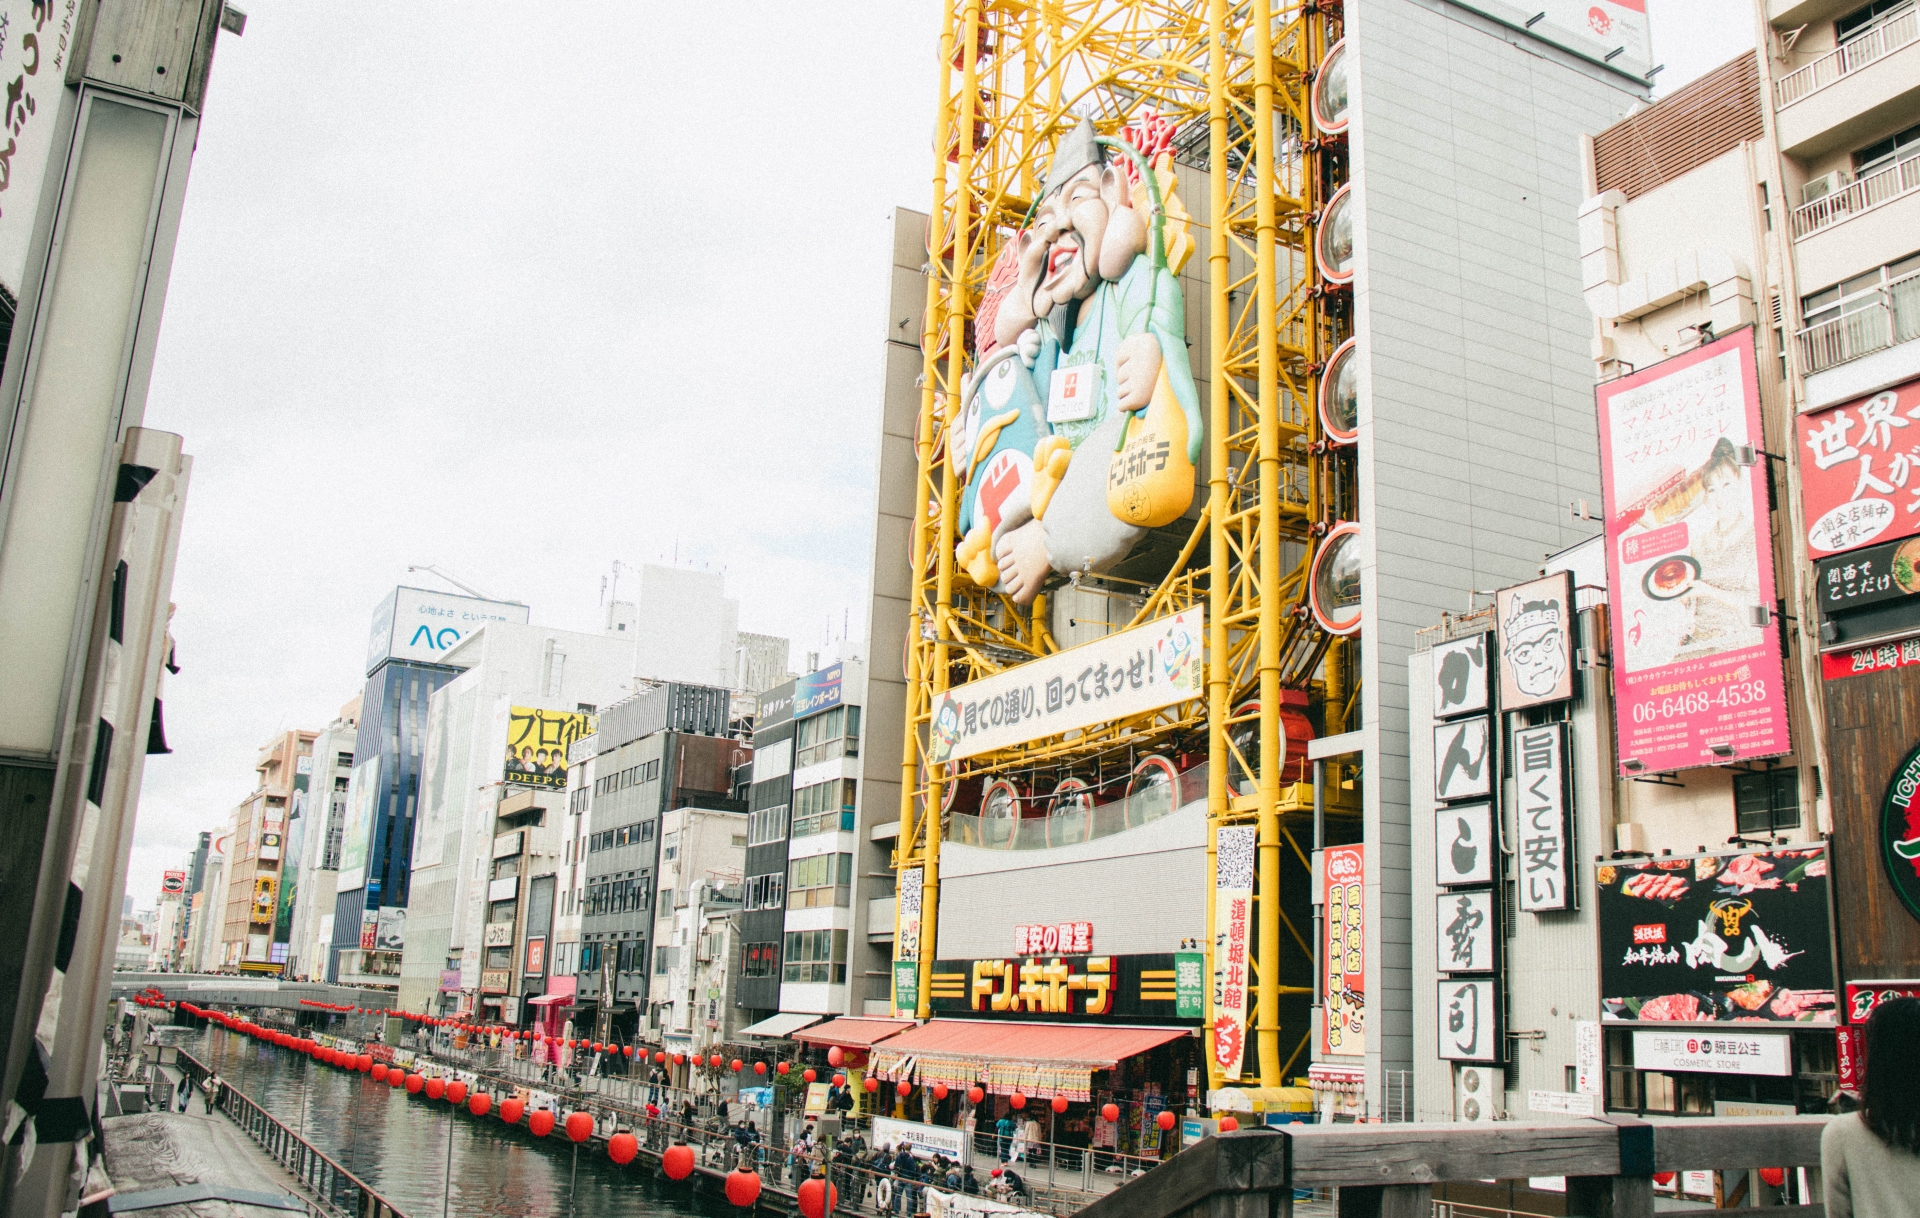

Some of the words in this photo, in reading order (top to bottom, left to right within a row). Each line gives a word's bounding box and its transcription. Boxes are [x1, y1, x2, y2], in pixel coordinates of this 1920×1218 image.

[1622, 383, 1727, 430] マダムシンコ
[1827, 561, 1872, 584] 関西で
[1829, 574, 1891, 601] ここだけ
[1650, 670, 1739, 696] お電話お待ちしております
[1633, 680, 1766, 723] 06-6468-4538
[508, 772, 553, 785] DEEP
[1522, 732, 1560, 903] 旨くて安い
[1014, 921, 1094, 956] 驚安の殿堂
[1223, 898, 1247, 1010] 道頓堀北館
[1673, 1058, 1712, 1068] COSMETIC
[1716, 1060, 1741, 1069] STORE
